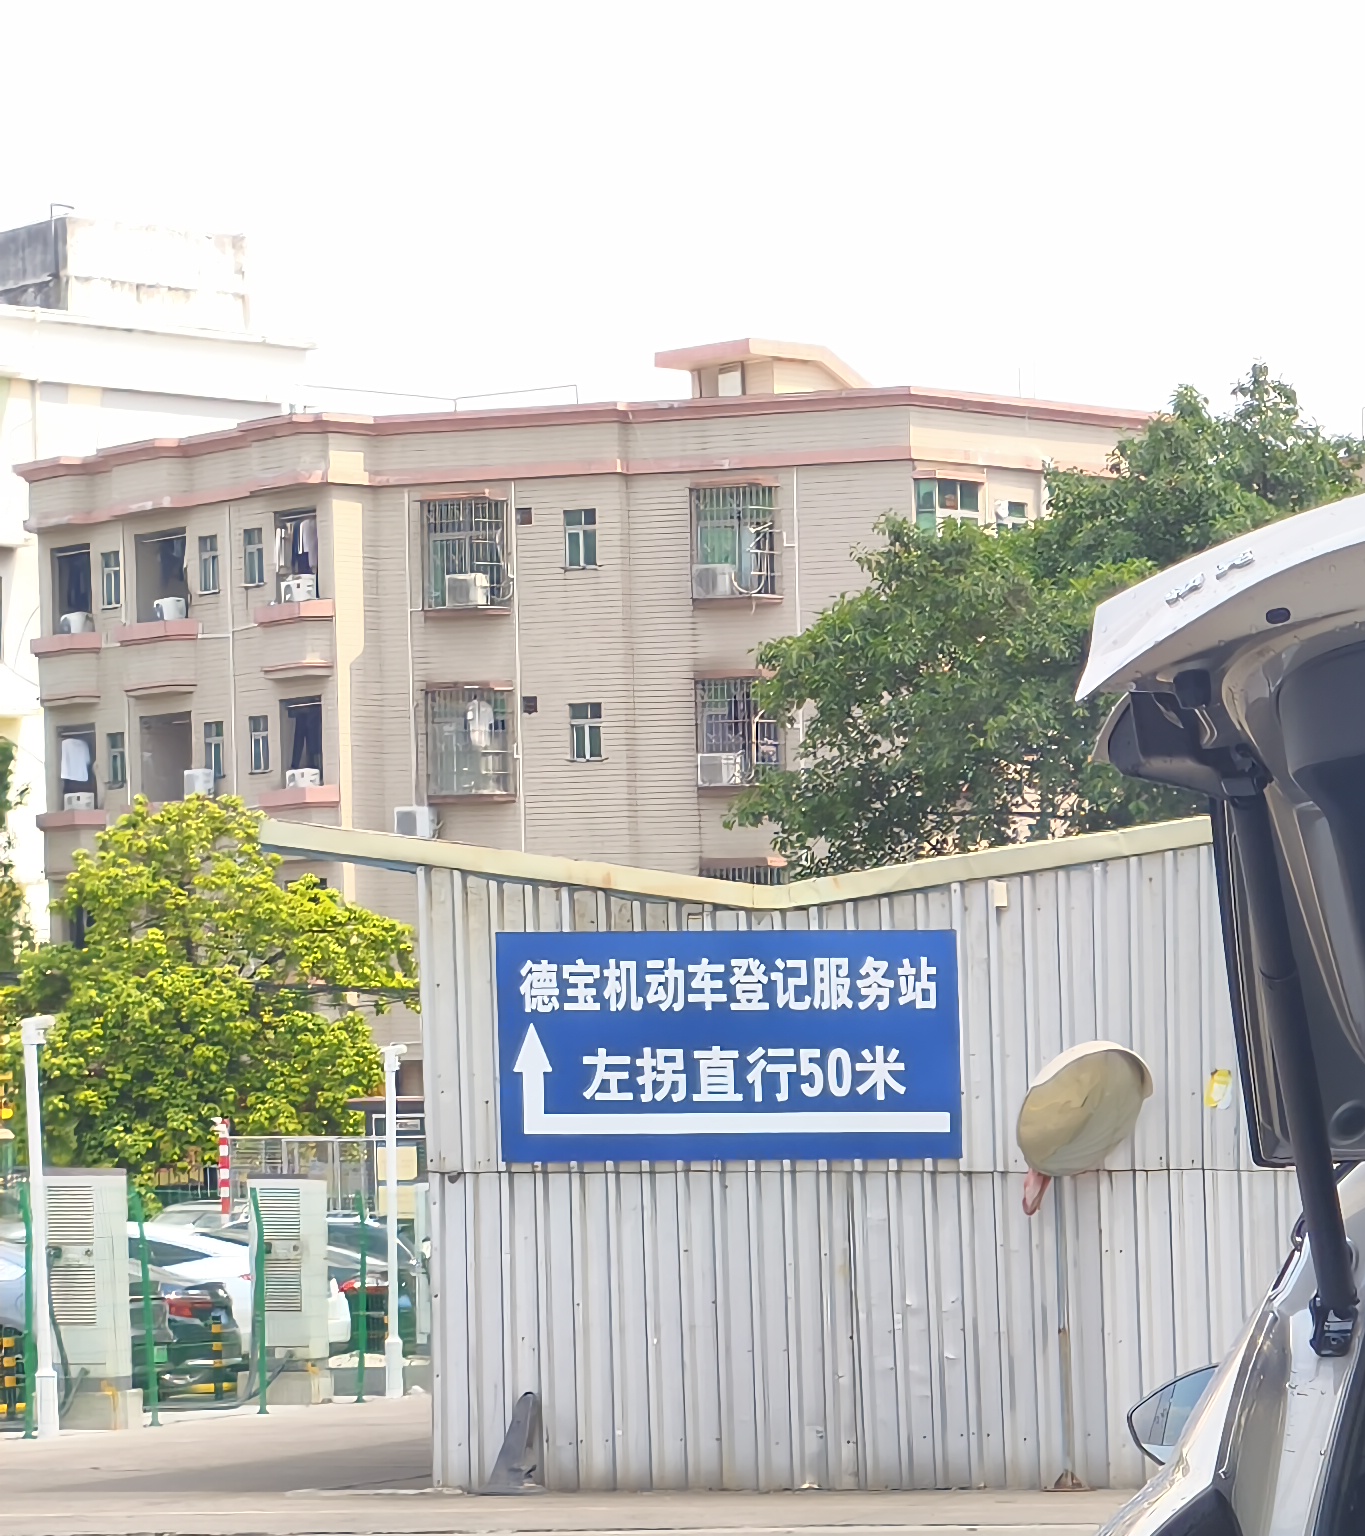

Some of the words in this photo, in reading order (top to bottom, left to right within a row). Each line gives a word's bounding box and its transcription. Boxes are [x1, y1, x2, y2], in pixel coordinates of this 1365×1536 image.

[519, 956, 937, 1013] 德宝机动车登记服务站
[582, 1045, 907, 1102] 左拐直行50米
